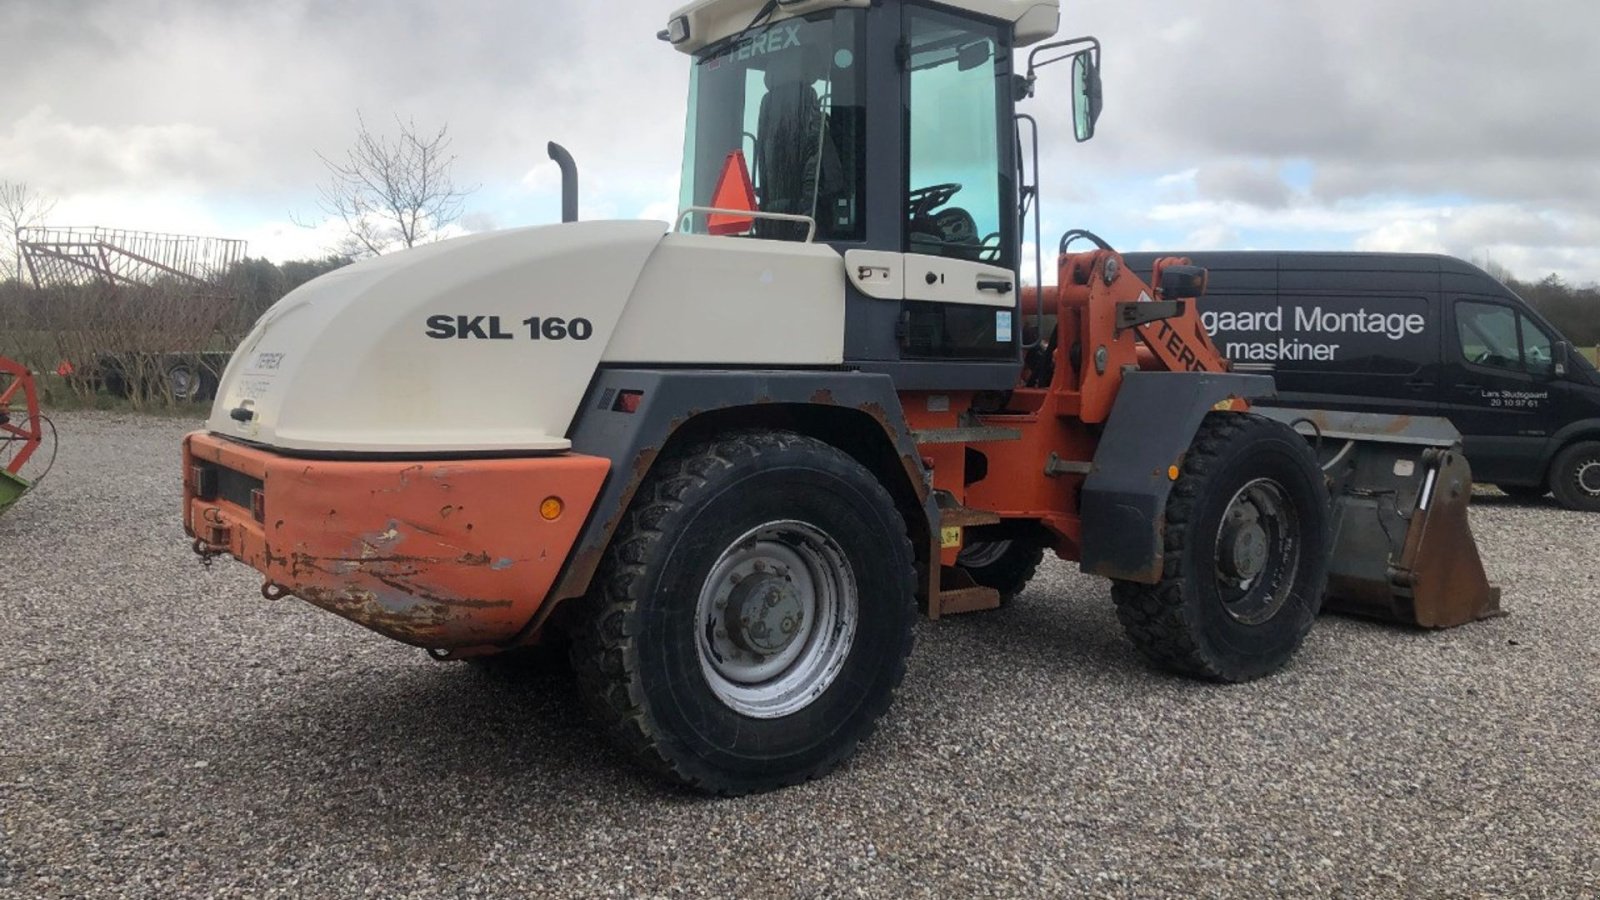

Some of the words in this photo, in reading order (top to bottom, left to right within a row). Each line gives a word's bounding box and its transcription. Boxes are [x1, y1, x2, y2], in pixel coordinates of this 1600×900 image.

[425, 315, 514, 339] SKL
[523, 316, 593, 340] 160
[1200, 306, 1282, 336] gaard
[1294, 306, 1425, 340] Montage
[1226, 338, 1340, 360] maskiner
[1503, 399, 1514, 407] 10
